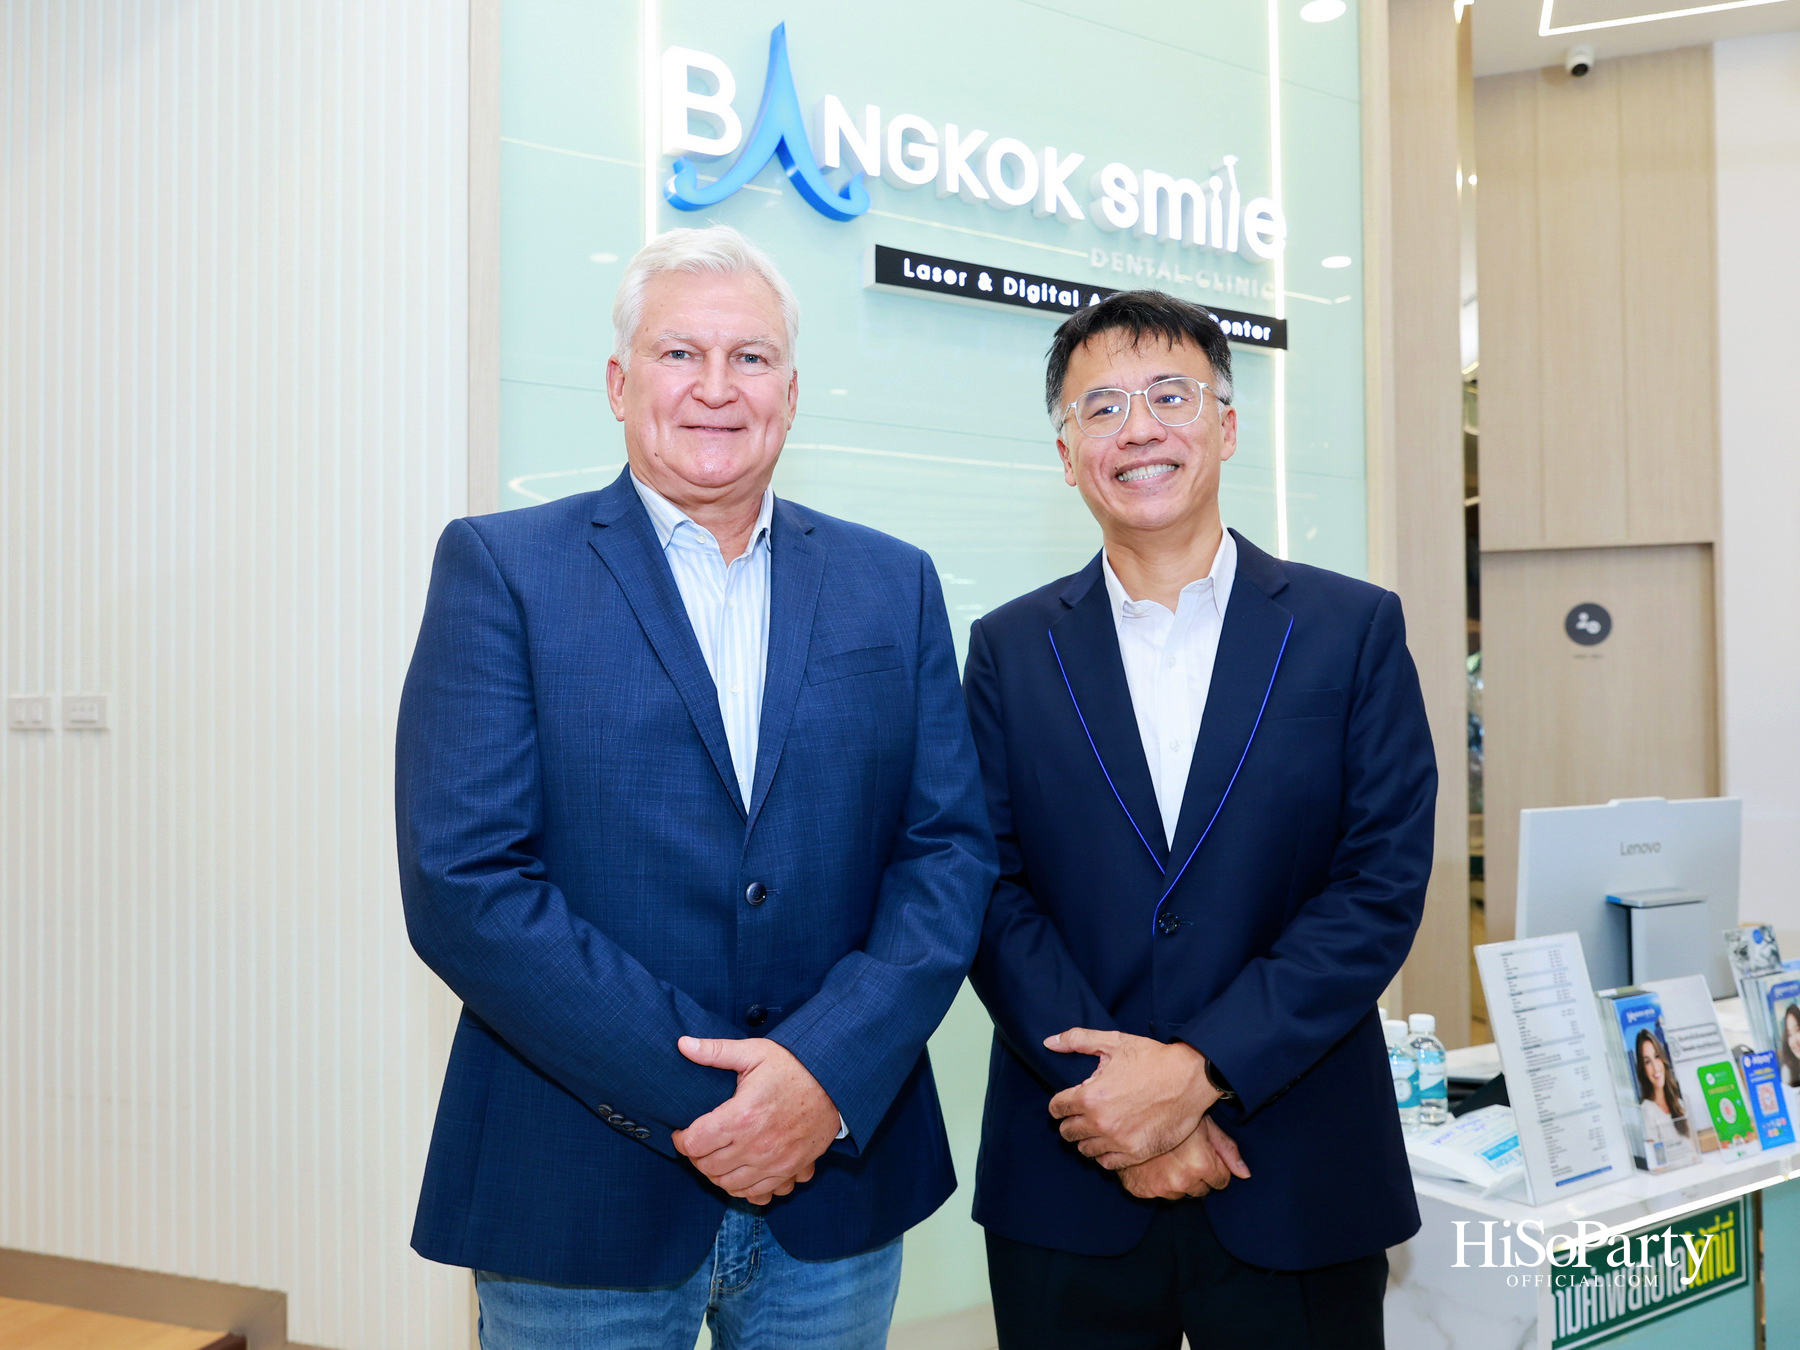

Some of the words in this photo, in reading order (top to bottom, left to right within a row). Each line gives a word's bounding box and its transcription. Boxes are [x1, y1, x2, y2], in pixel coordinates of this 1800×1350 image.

[660, 20, 1085, 222] BANGKOK
[903, 257, 967, 287] Laser
[978, 271, 993, 292] &
[1003, 276, 1080, 308] Digital
[1090, 247, 1187, 284] DENTAL
[1195, 269, 1275, 300] CLINIC
[1620, 841, 1662, 856] Lenovo
